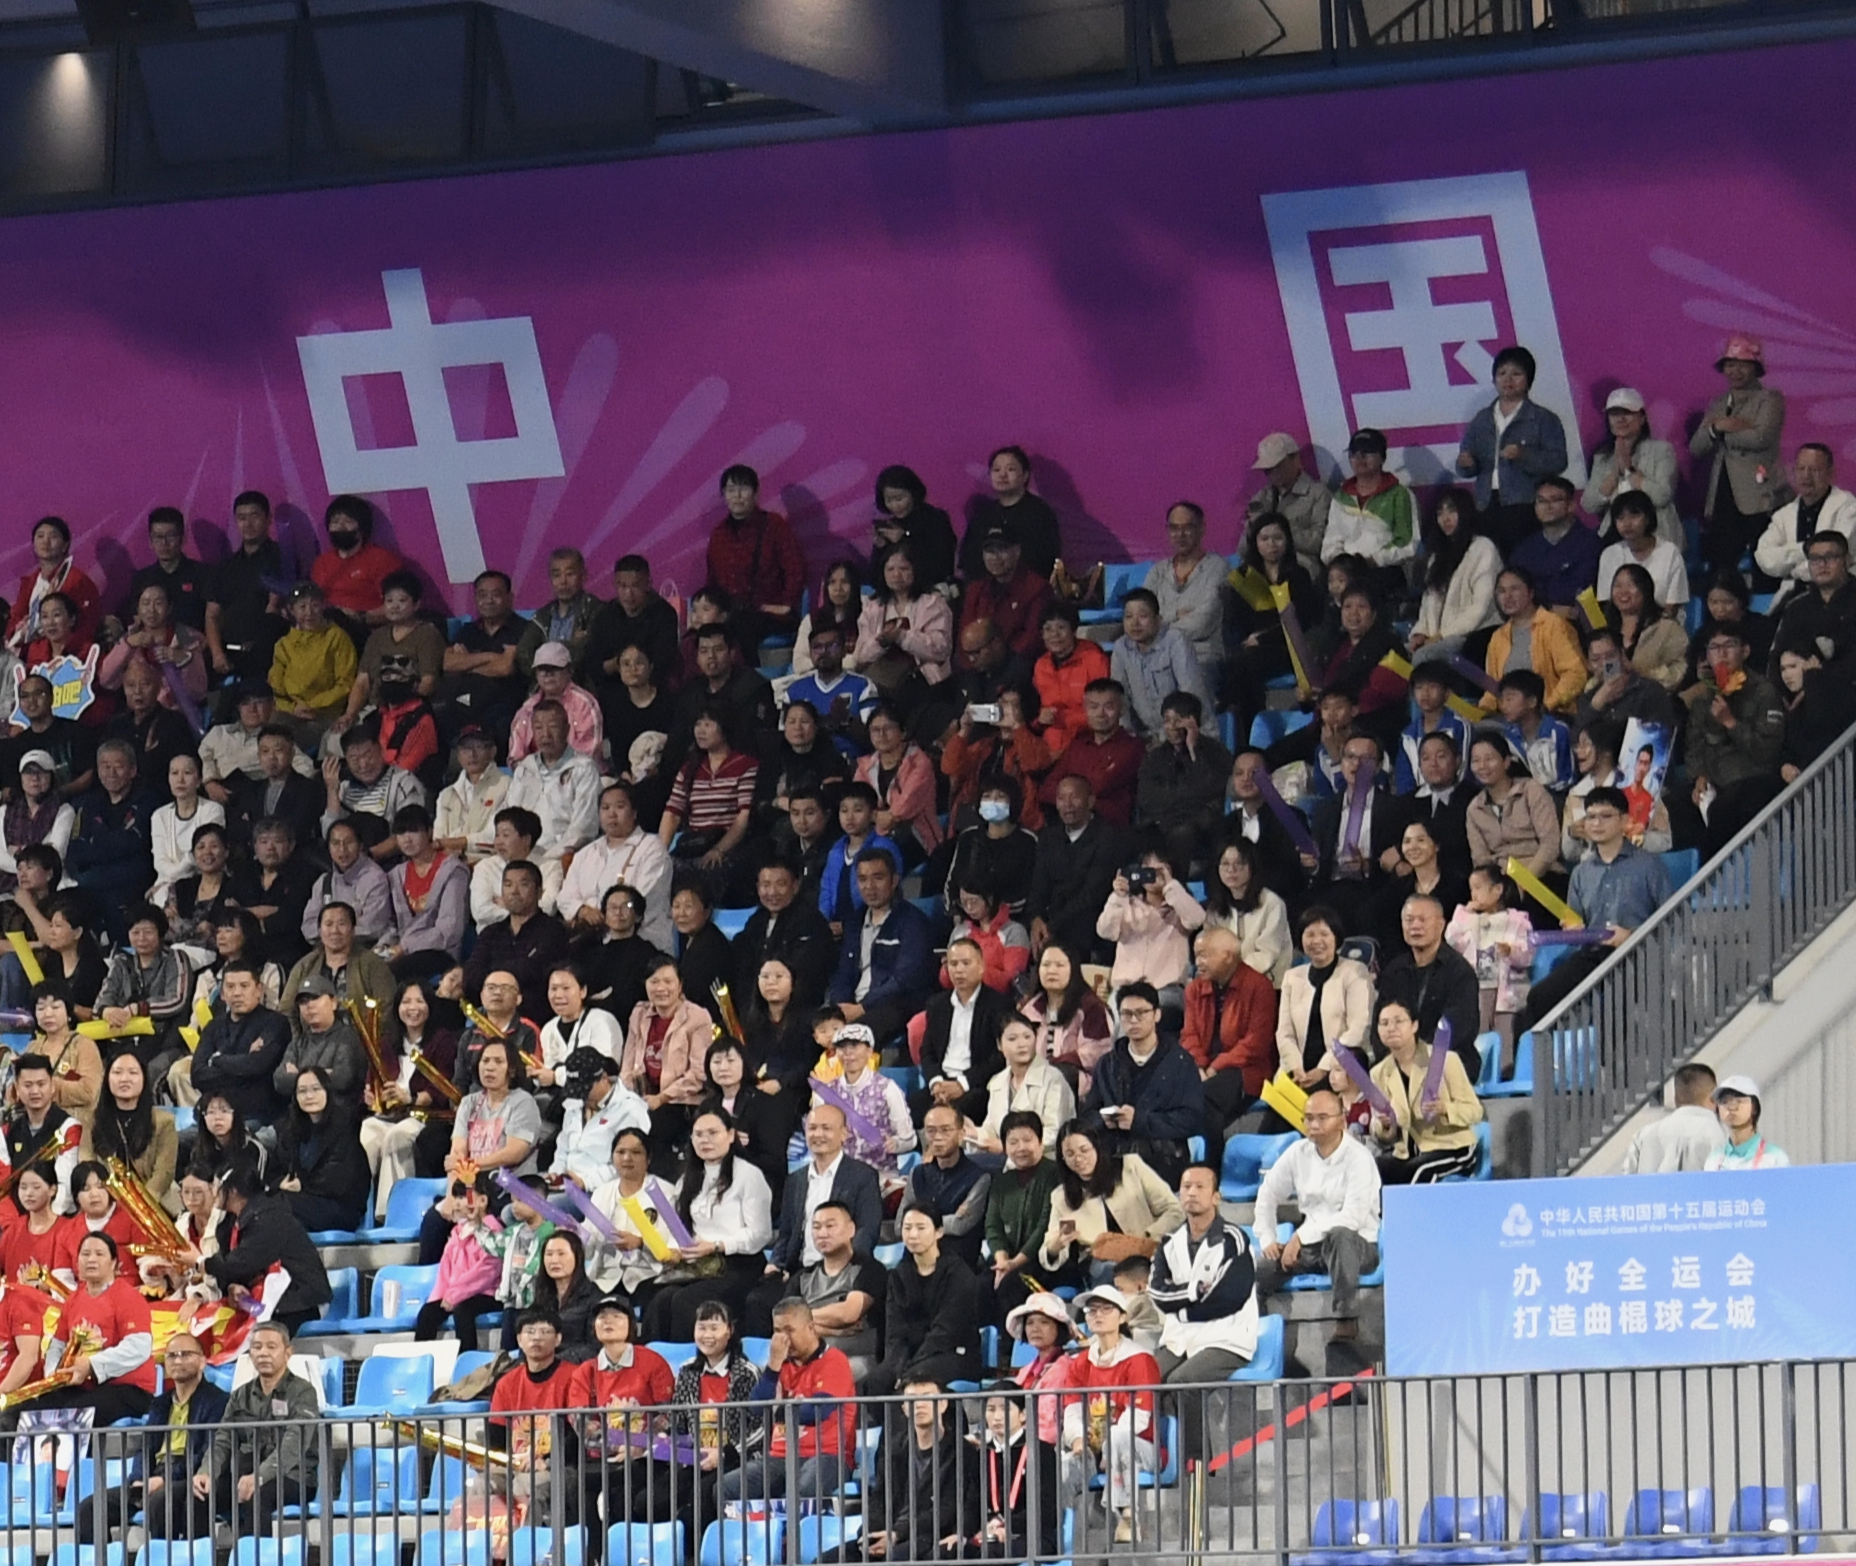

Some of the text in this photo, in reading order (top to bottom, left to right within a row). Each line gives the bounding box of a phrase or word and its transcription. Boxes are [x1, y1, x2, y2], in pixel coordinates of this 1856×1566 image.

[296, 171, 1591, 583] 中 国
[1540, 1197, 1767, 1226] 中华人民共和国第十五届运动会
[1512, 1252, 1755, 1297] 办好全运会
[1513, 1295, 1756, 1339] 打造曲棍球之城
